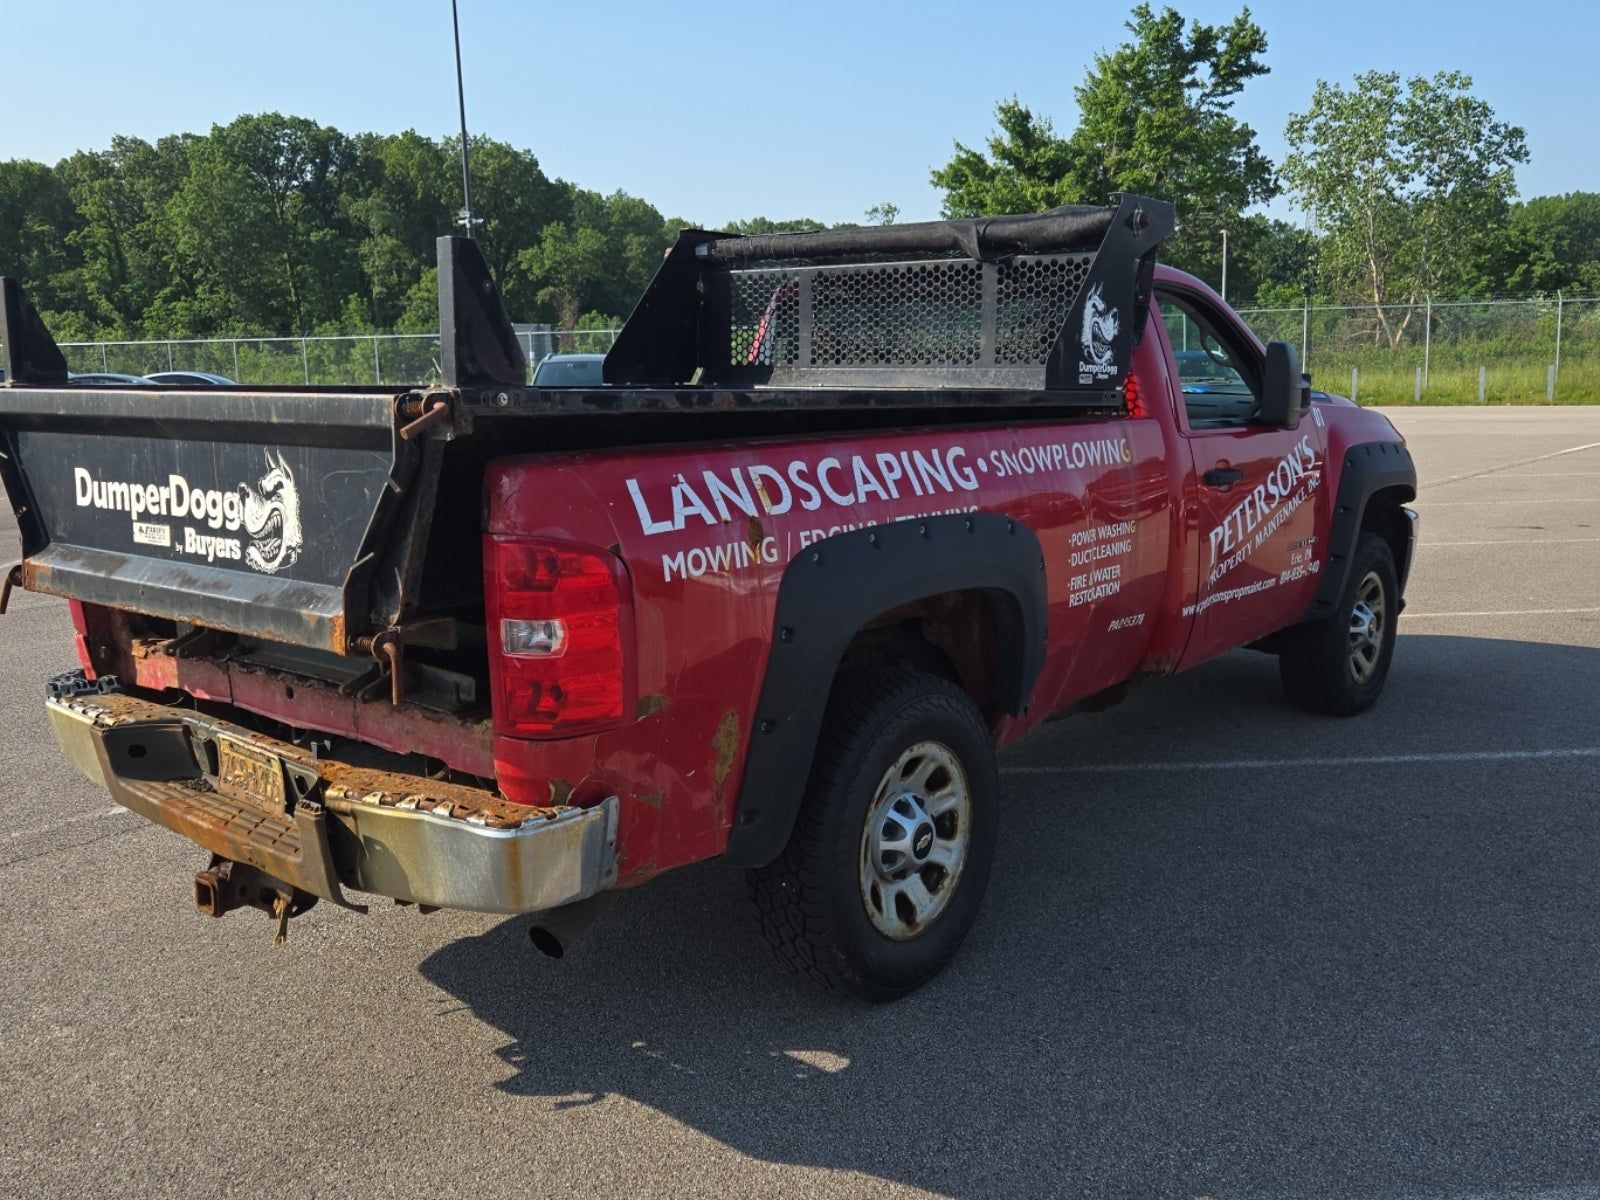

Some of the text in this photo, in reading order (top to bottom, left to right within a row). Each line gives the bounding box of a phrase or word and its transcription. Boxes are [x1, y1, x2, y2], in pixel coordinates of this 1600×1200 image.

[74, 467, 242, 530] DumperDogg
[625, 446, 979, 536] LANDSCAPING
[990, 437, 1131, 477] SNOWPLOWING
[1209, 434, 1315, 567] PETERSON'S
[184, 526, 241, 562] Buyers
[1098, 520, 1136, 539] WASHING
[661, 536, 778, 582] MOWING
[1070, 574, 1087, 591] FIRE
[1093, 565, 1121, 583] WATER
